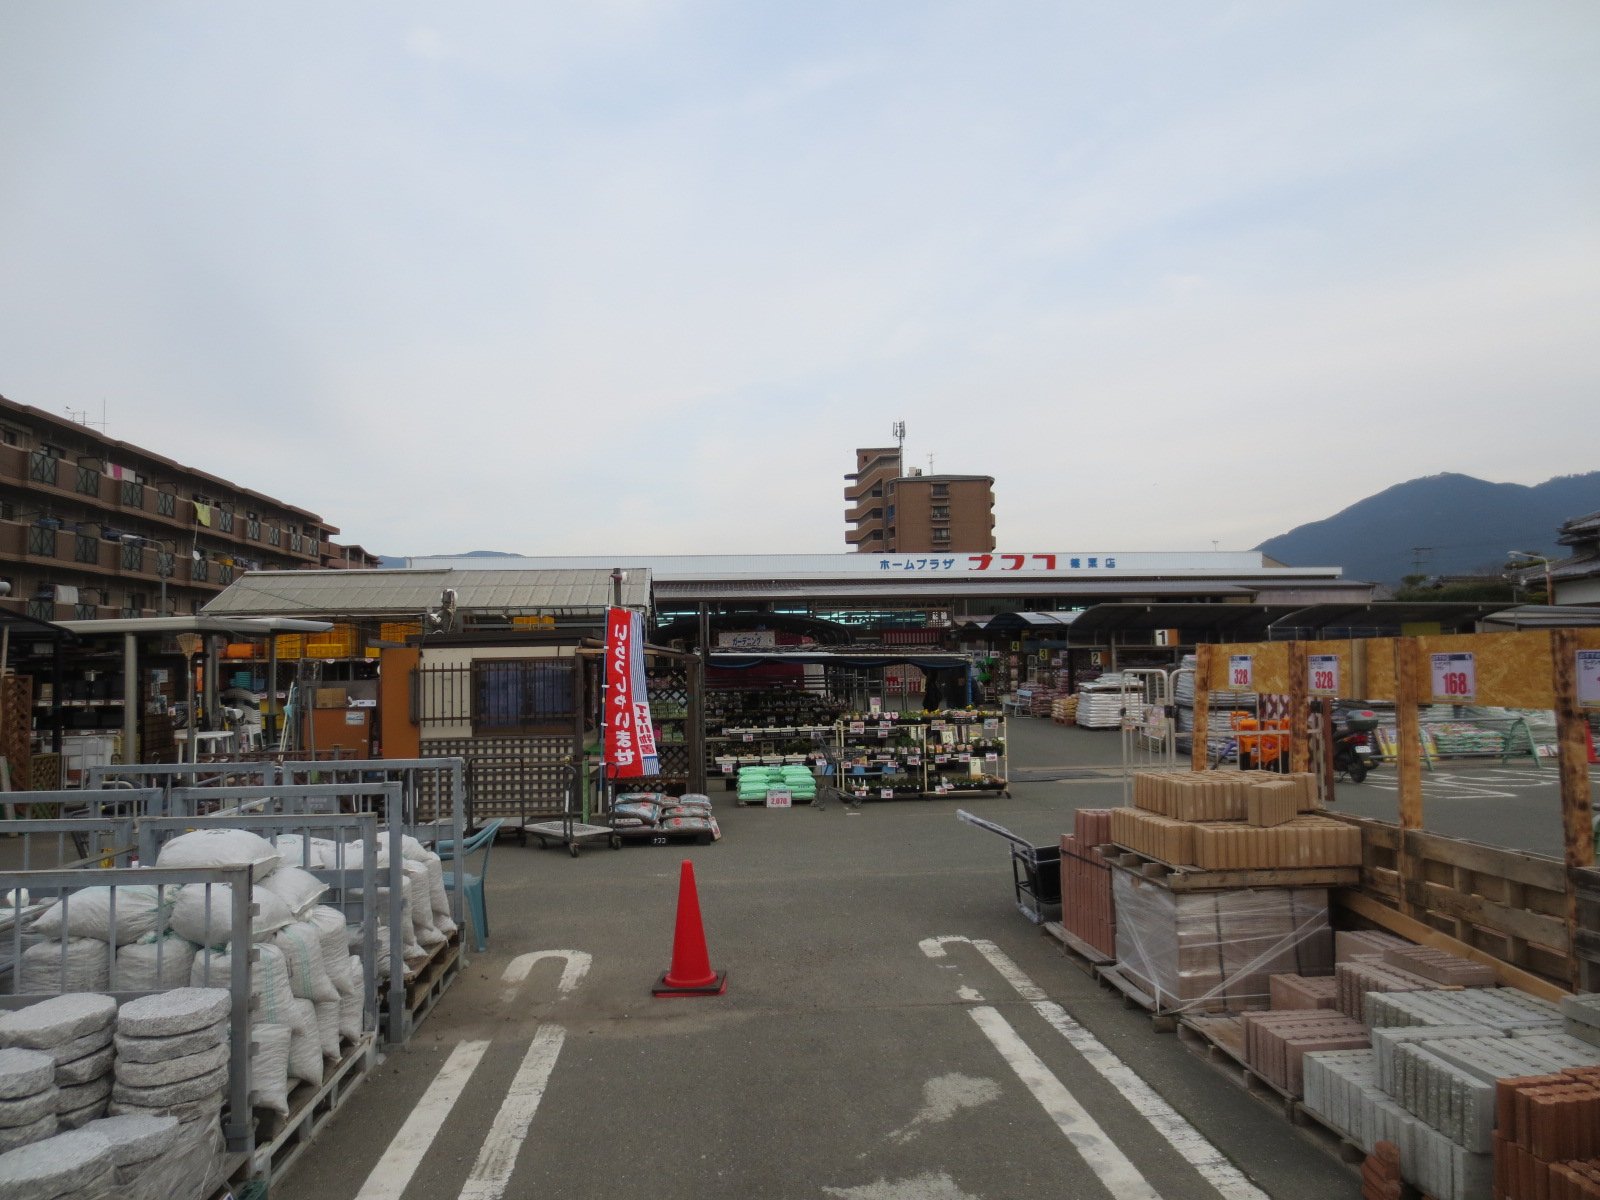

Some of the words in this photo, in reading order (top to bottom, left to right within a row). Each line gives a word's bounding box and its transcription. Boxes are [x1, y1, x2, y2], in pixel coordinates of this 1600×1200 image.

[879, 558, 955, 570] ホームプラザ
[968, 554, 1056, 571] ナフコ
[1157, 631, 1167, 645] 1
[1012, 641, 1019, 651] 4
[1040, 649, 1047, 660] 3
[1092, 652, 1100, 665] 2
[1234, 669, 1248, 685] 328
[1315, 671, 1333, 689] 328
[1442, 672, 1467, 695] 168
